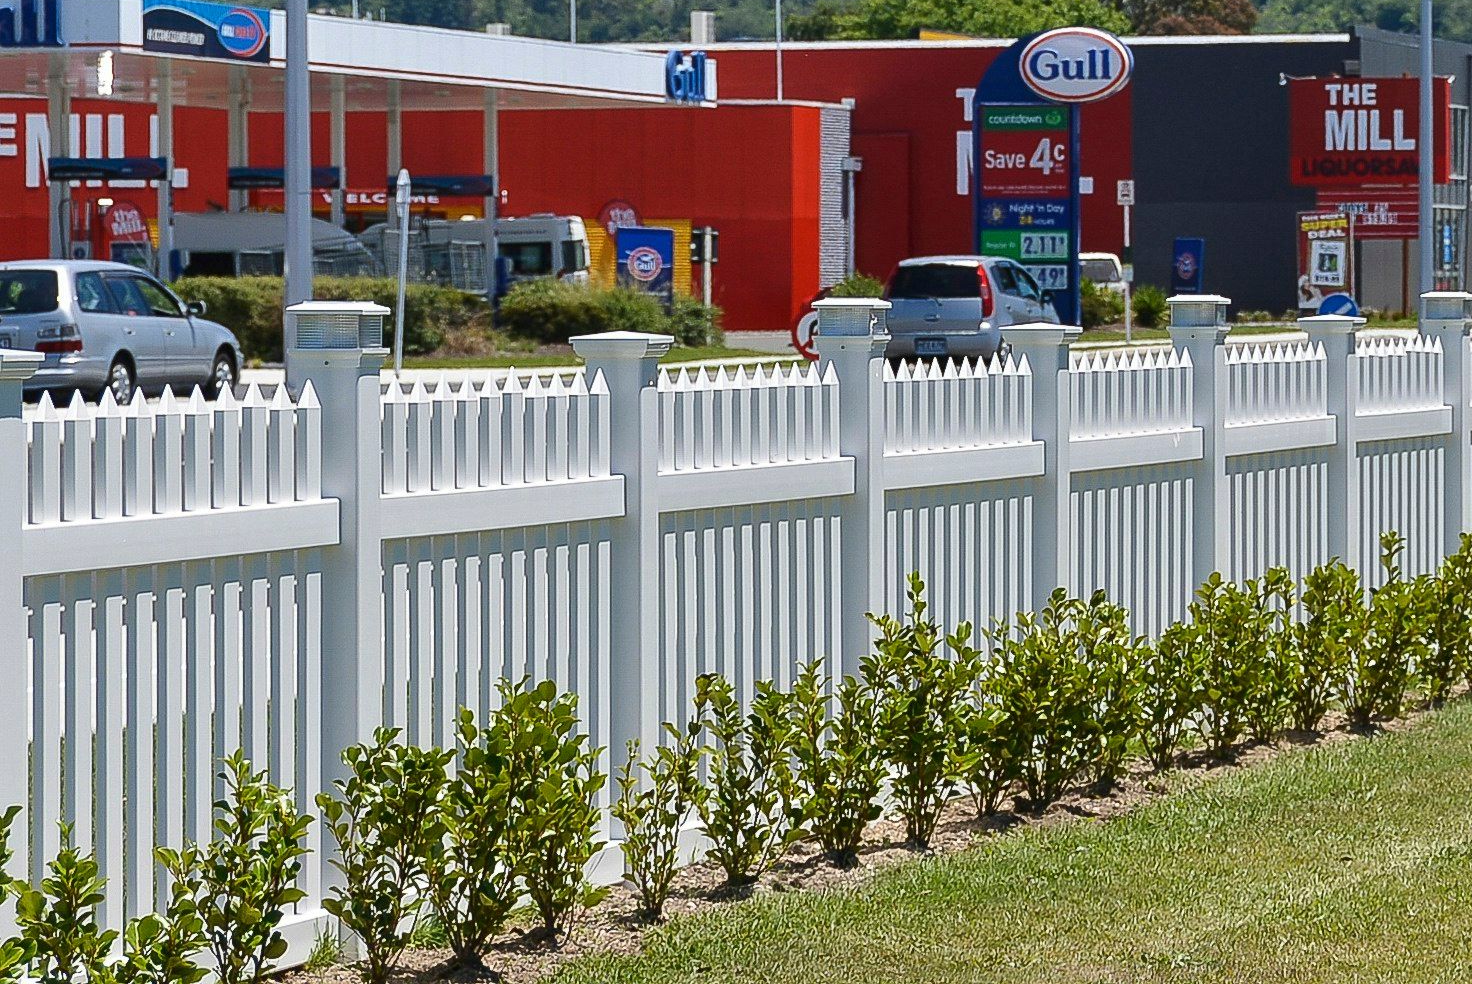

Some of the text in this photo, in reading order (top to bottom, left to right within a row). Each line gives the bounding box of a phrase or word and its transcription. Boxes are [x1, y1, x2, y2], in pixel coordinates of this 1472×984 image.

[1029, 48, 1112, 81] Gull
[1324, 83, 1377, 106] THE
[988, 113, 1043, 125] countdown
[1324, 109, 1416, 151] MILL
[984, 149, 1026, 169] Save
[1302, 157, 1420, 177] LIQUORSA
[322, 193, 440, 204] WELCME
[1046, 203, 1065, 214] Day
[1301, 219, 1348, 232] SUPER
[1307, 229, 1346, 239] DEAL
